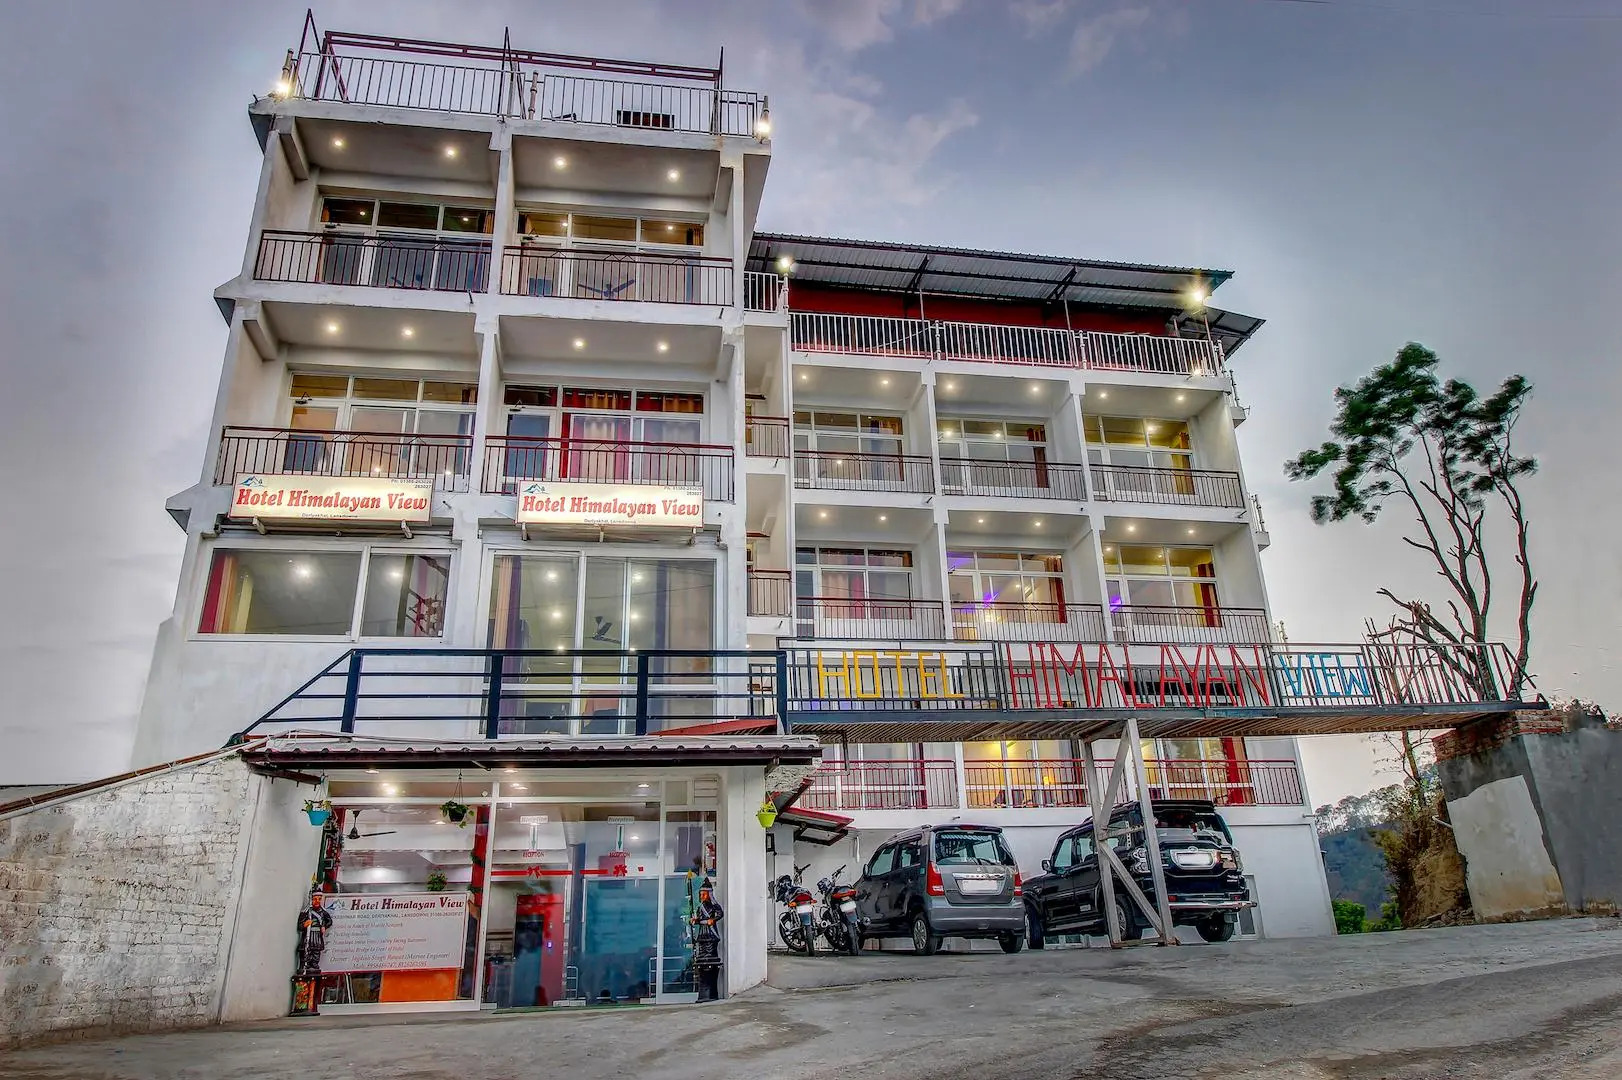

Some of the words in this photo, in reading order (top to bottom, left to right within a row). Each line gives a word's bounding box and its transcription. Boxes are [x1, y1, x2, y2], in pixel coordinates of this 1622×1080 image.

[236, 488, 284, 506] Hotel
[286, 489, 382, 512] Himalayan
[387, 493, 428, 510] View
[522, 495, 566, 512] Hotel
[569, 496, 656, 518] Himalayan
[661, 499, 700, 516] View
[817, 650, 964, 698] HOTEL
[1005, 643, 1271, 708] HIMALAYAN
[1278, 653, 1371, 697] VIEW
[350, 898, 378, 910] Hotel
[381, 897, 436, 911] Himalayan
[439, 896, 464, 908] View
